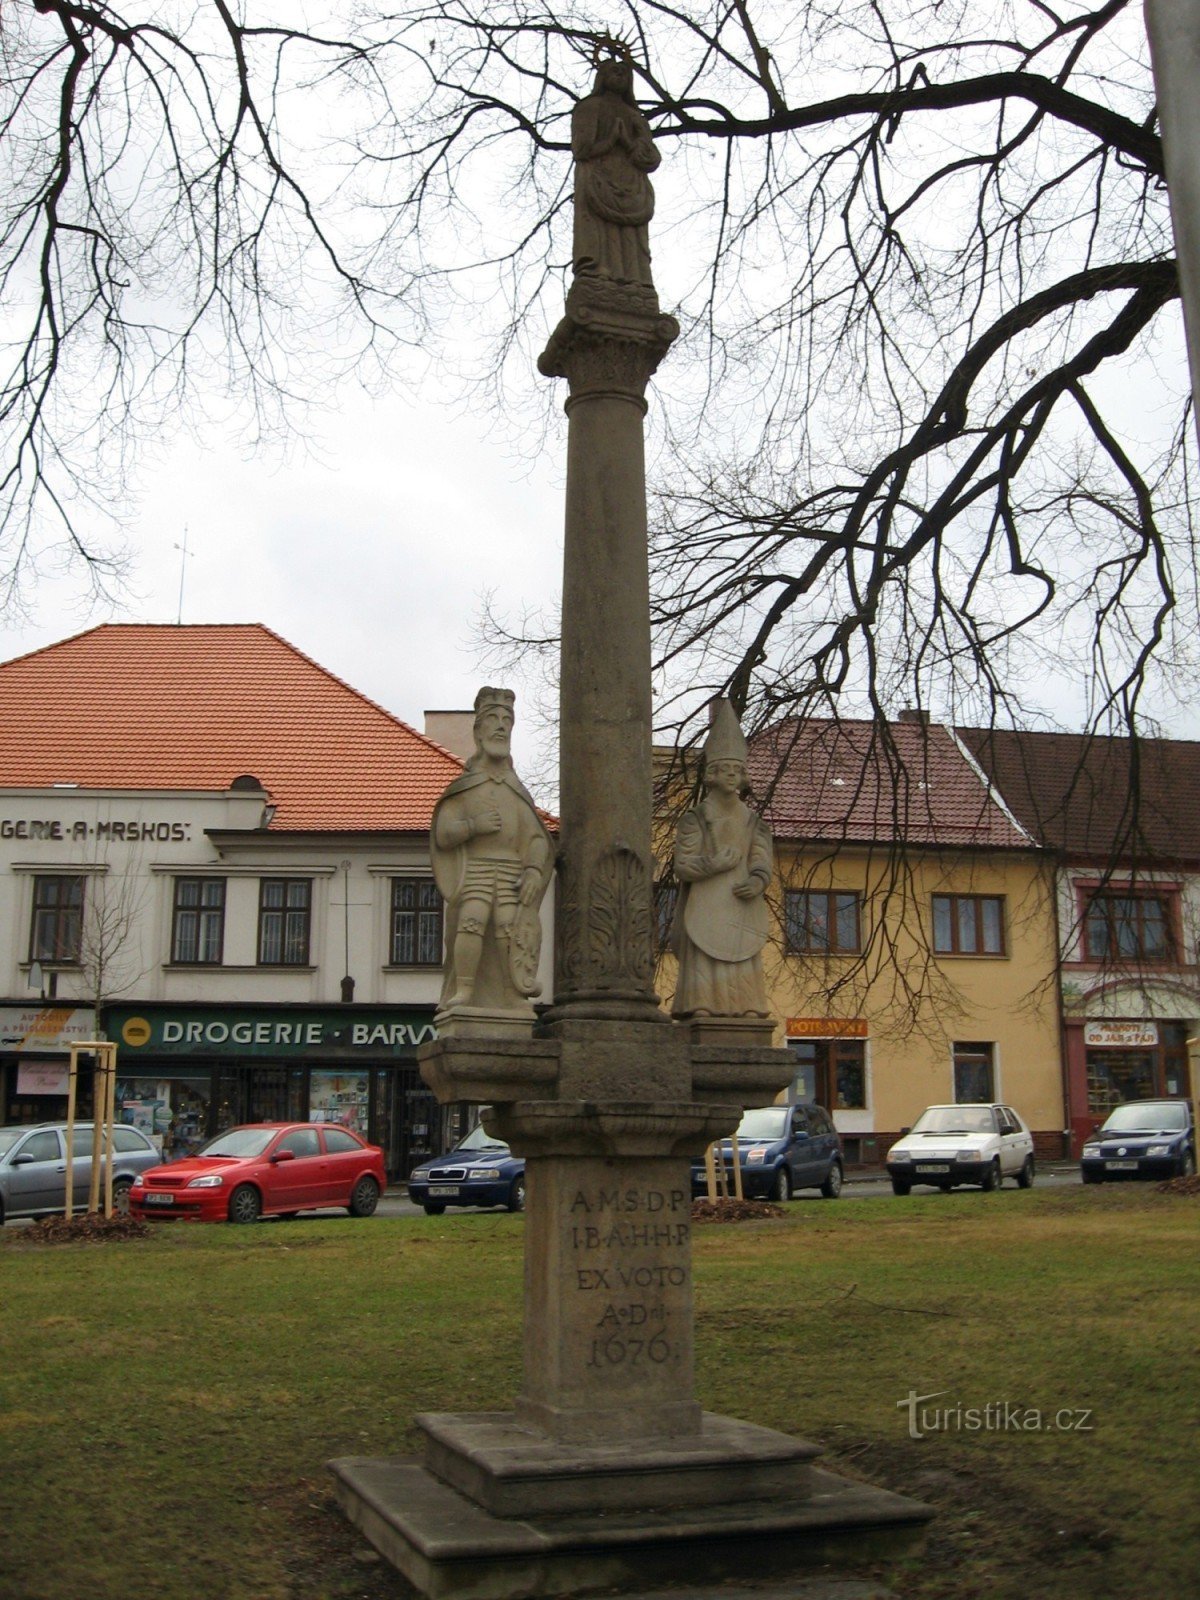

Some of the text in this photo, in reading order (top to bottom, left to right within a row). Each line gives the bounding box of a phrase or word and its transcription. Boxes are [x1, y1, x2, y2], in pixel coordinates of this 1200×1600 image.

[162, 1021, 440, 1045] DROGERIE BARVY
[577, 1266, 686, 1290] EX VOTO
